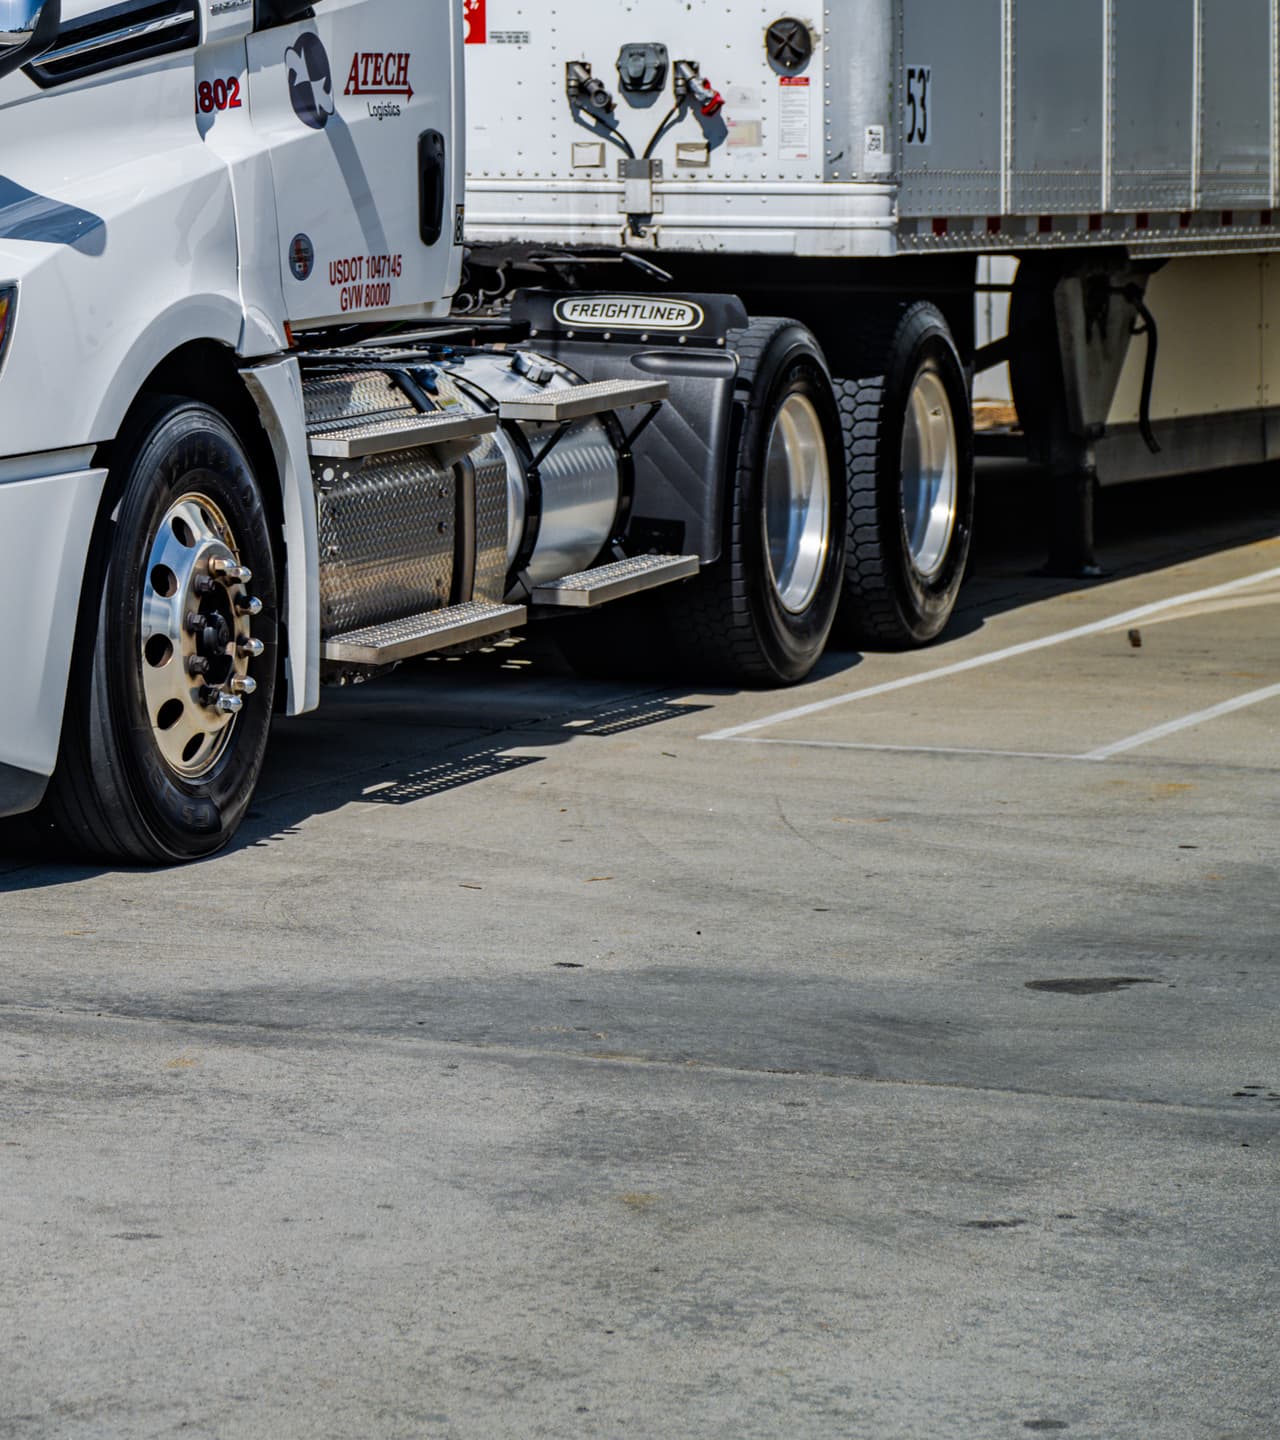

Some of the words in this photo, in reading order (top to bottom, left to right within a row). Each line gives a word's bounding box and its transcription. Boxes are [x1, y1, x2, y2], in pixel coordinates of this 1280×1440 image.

[344, 52, 411, 96] ATECH
[367, 101, 401, 120] Logistics
[329, 256, 364, 286] USDOT
[366, 254, 402, 279] 1047145
[340, 284, 363, 311] GVW
[365, 283, 391, 307] 80000
[570, 303, 686, 321] FREIGHTLINER
